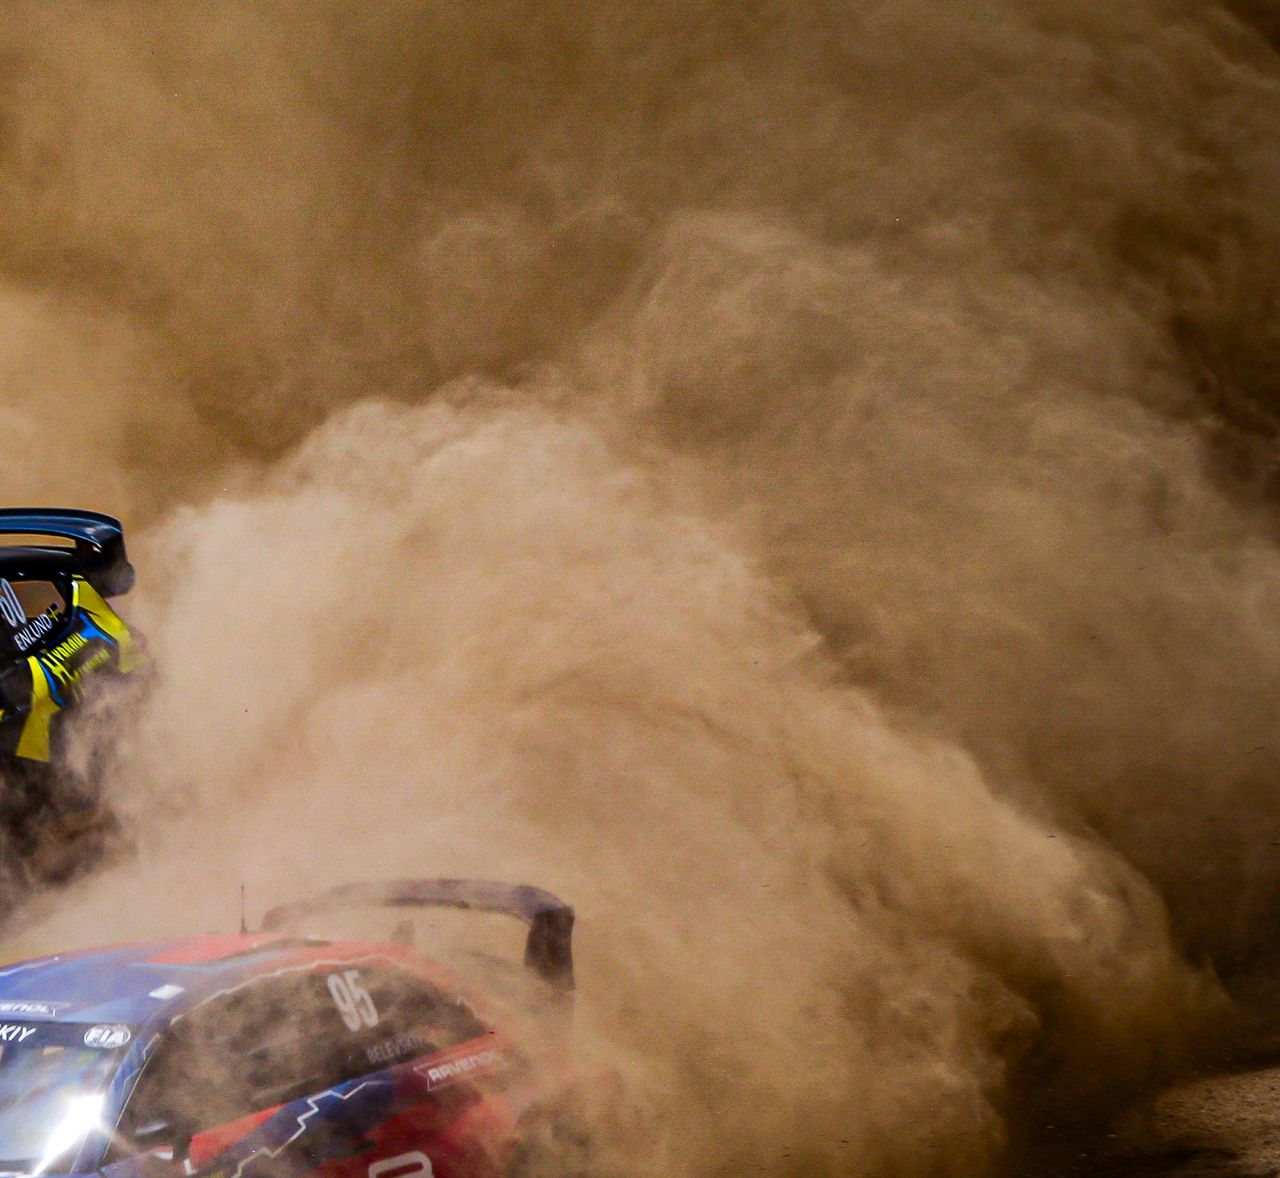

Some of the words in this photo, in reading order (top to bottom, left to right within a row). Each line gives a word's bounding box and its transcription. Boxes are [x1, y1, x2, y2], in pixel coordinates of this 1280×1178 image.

[13, 613, 53, 652] ENLUND
[327, 970, 379, 1032] 95
[426, 1050, 498, 1082] RAVENO
